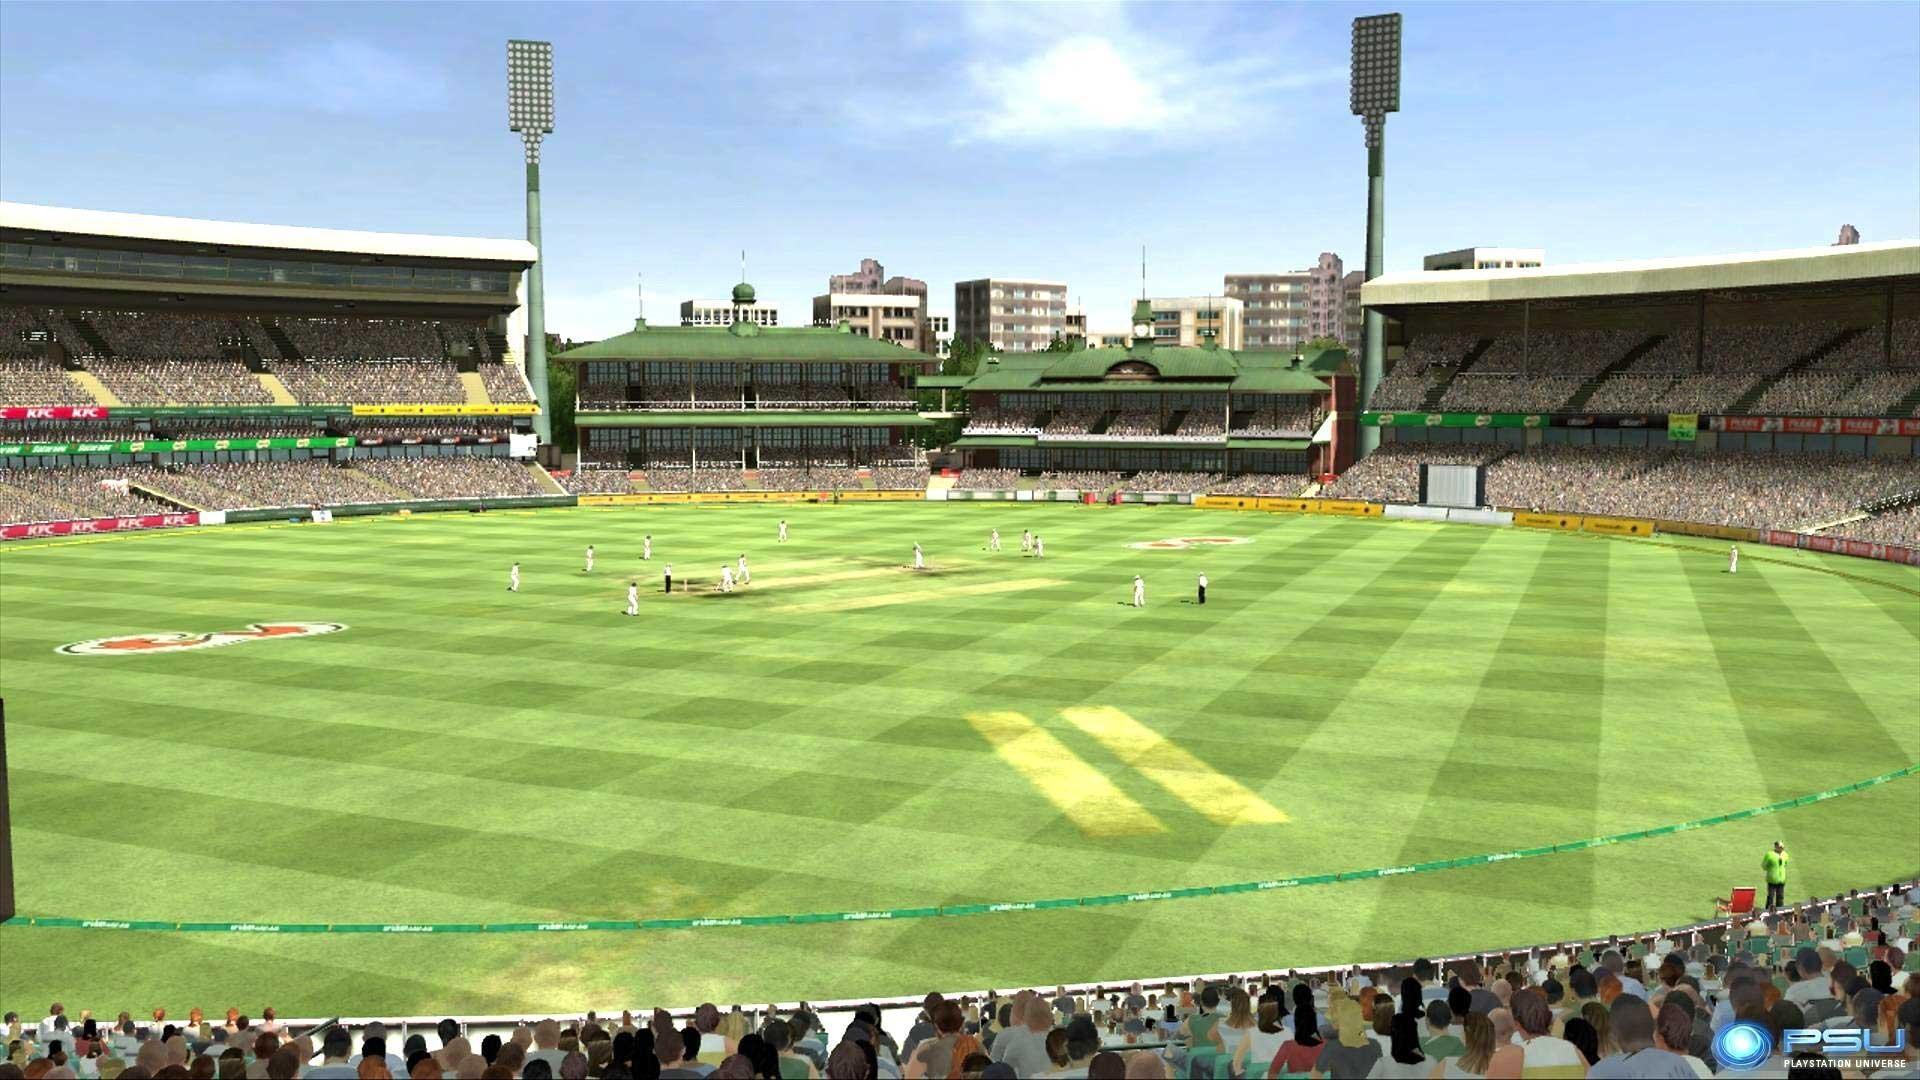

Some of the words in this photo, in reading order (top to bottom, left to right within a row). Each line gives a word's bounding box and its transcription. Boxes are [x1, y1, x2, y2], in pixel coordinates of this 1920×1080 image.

[26, 409, 54, 418] KFC
[71, 408, 98, 417] KFC
[117, 519, 145, 528] KFC
[163, 515, 189, 525] KFC
[27, 525, 54, 536] KFC
[71, 522, 98, 532] KFC
